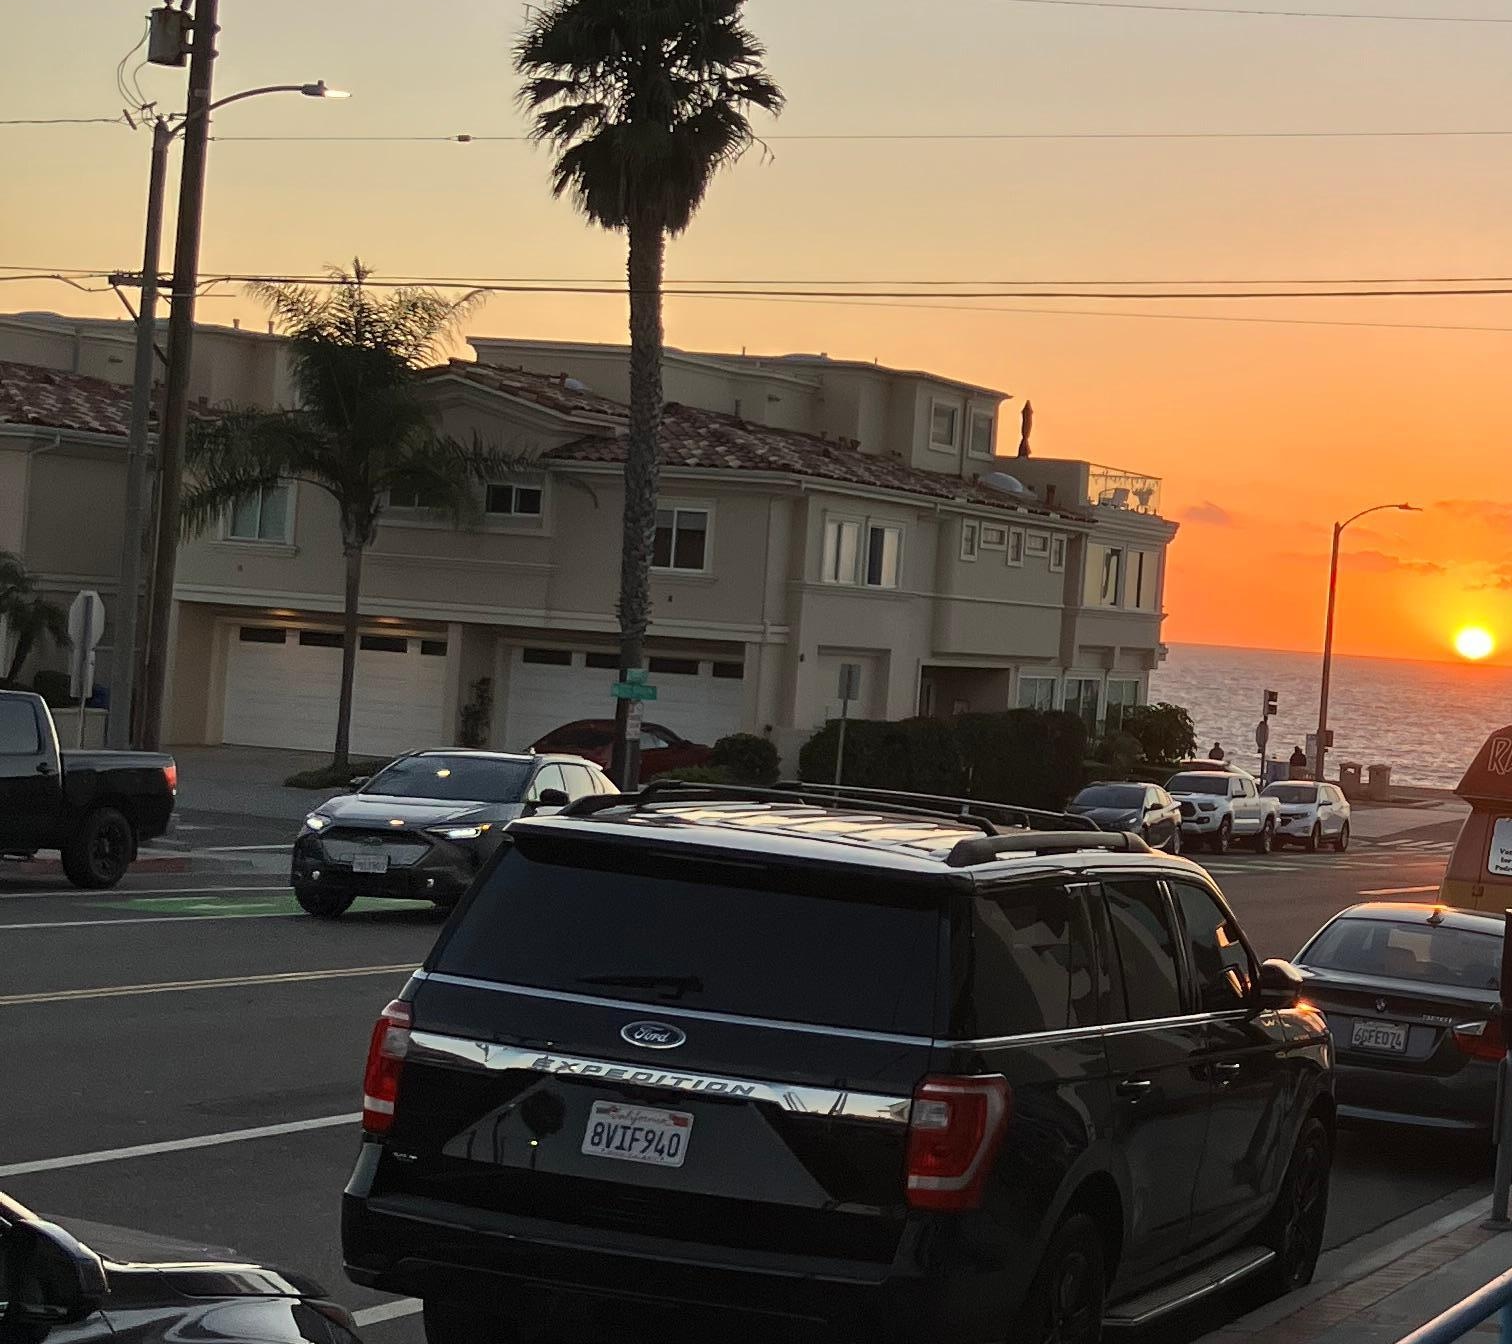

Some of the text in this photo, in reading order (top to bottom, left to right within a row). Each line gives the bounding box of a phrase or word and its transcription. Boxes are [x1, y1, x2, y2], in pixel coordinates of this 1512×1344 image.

[633, 1026, 672, 1043] Ford
[531, 1056, 757, 1096] EXPEDITION
[590, 1121, 682, 1159] 8VIF940
